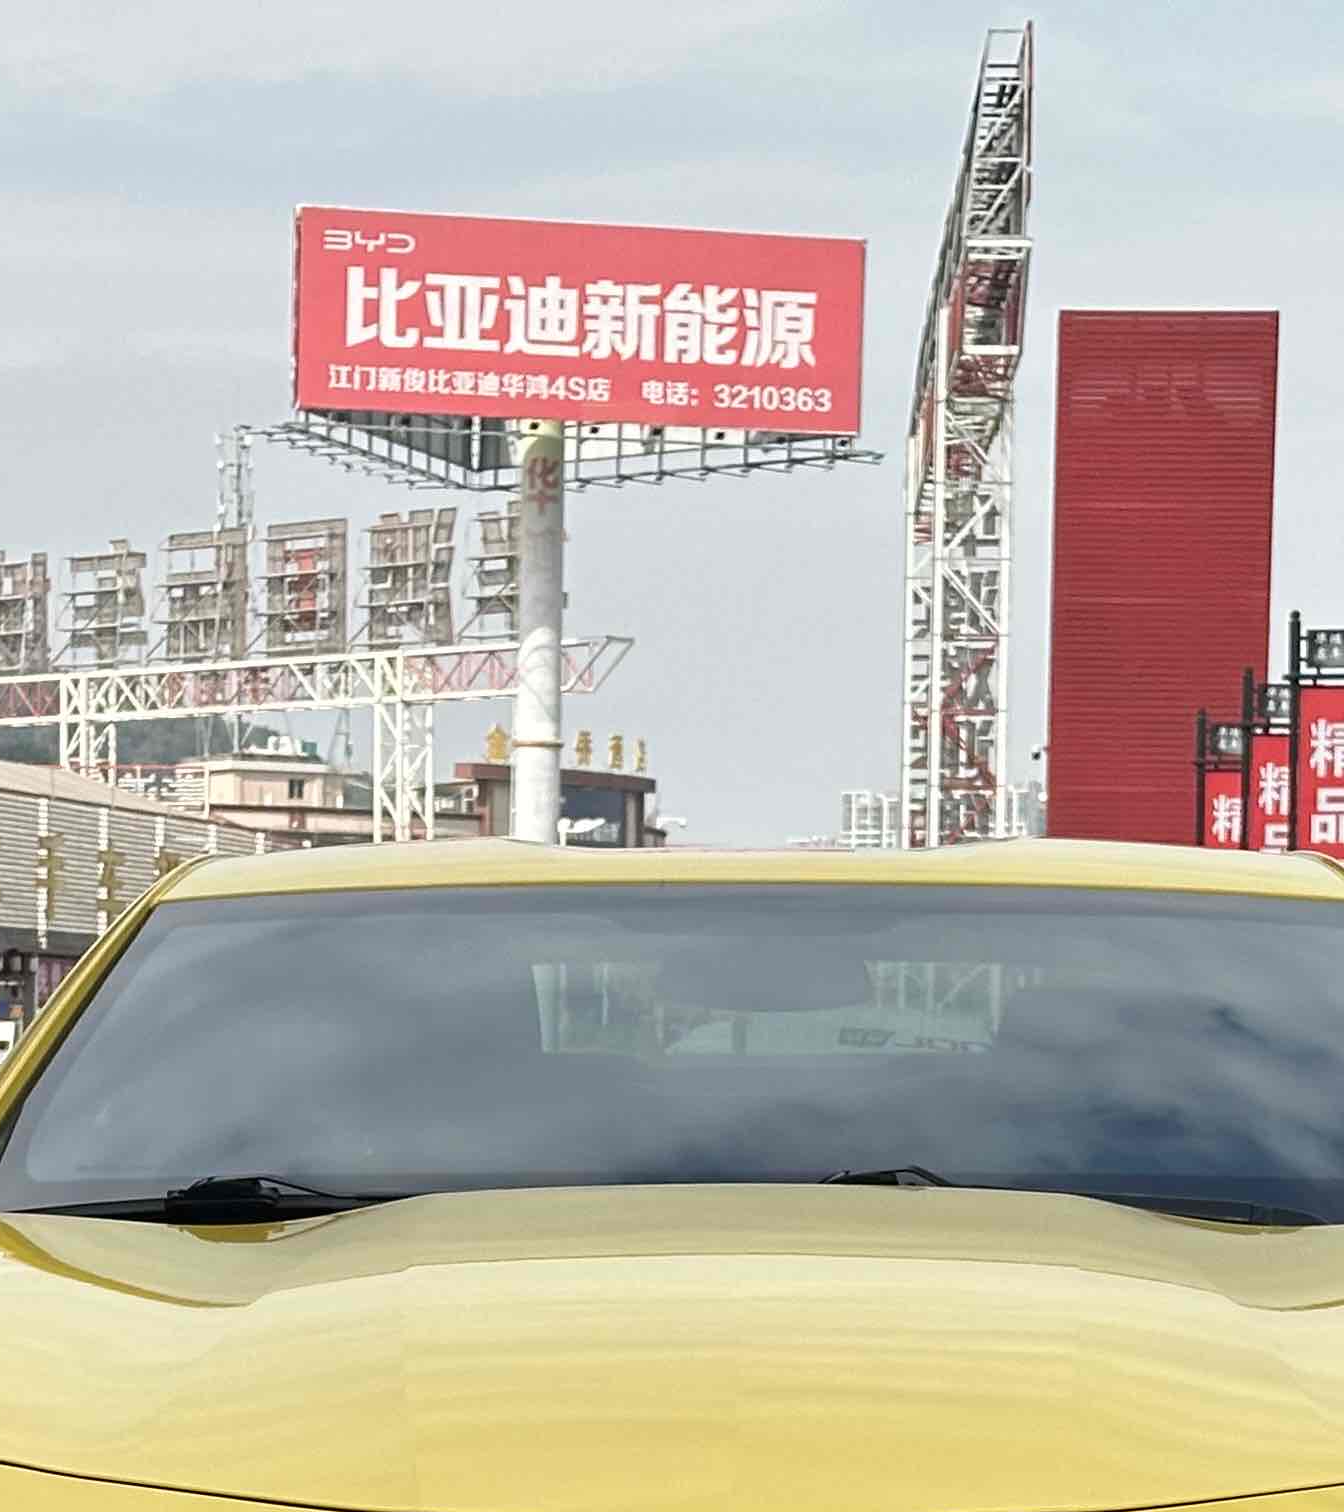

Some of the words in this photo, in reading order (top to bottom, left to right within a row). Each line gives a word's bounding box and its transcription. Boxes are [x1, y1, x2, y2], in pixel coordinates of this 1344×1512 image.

[323, 229, 416, 254] BYD
[345, 265, 818, 370] 比亚迪新能源
